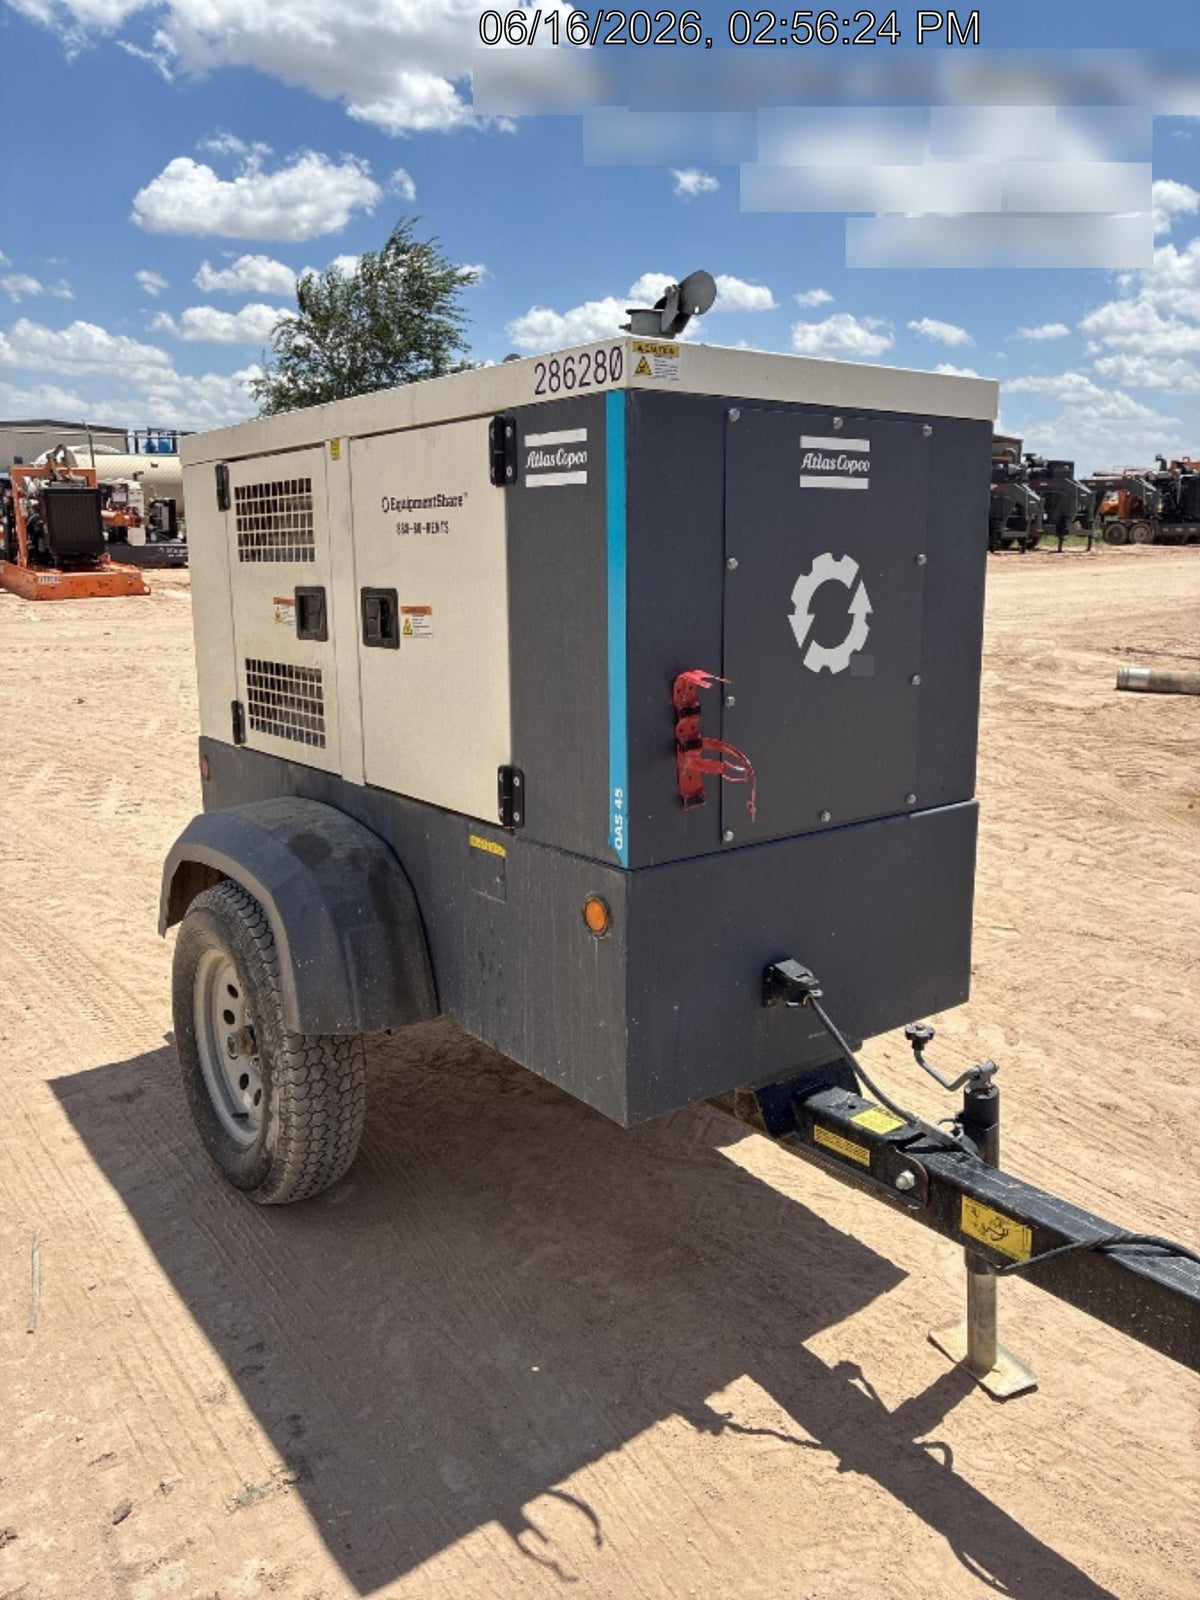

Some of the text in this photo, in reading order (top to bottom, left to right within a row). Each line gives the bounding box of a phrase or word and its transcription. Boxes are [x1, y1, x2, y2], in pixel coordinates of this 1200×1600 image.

[534, 346, 623, 396] 286280
[525, 447, 588, 469] Atlas Copco
[801, 452, 870, 475] Atlas Copco
[614, 788, 623, 850] QAS 45
